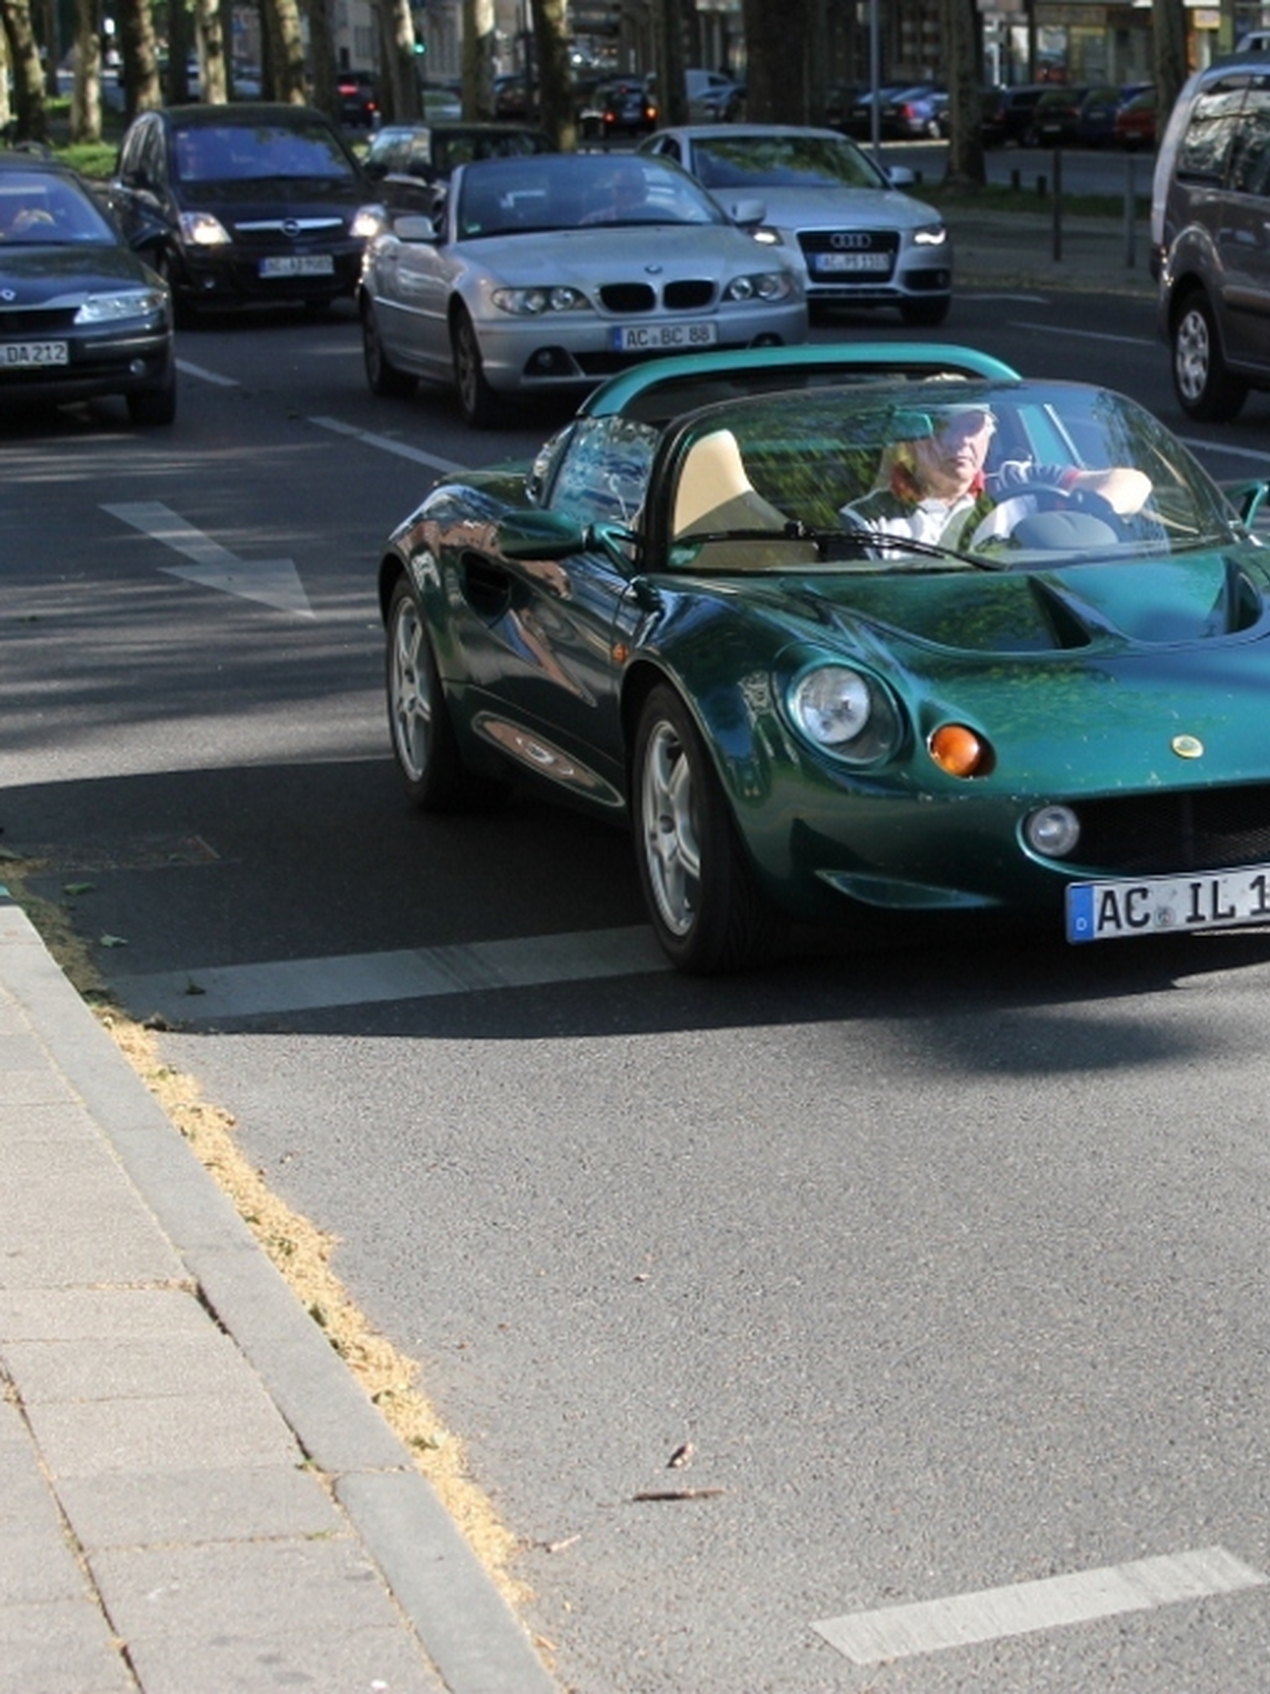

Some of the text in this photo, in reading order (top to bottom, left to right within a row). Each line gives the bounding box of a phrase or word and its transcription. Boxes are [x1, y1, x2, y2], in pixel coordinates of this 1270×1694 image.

[627, 325, 711, 347] AC BC 88
[7, 344, 66, 363] DA 212
[1097, 887, 1151, 932] AC
[1185, 880, 1236, 924] IL
[1075, 916, 1088, 932] D
